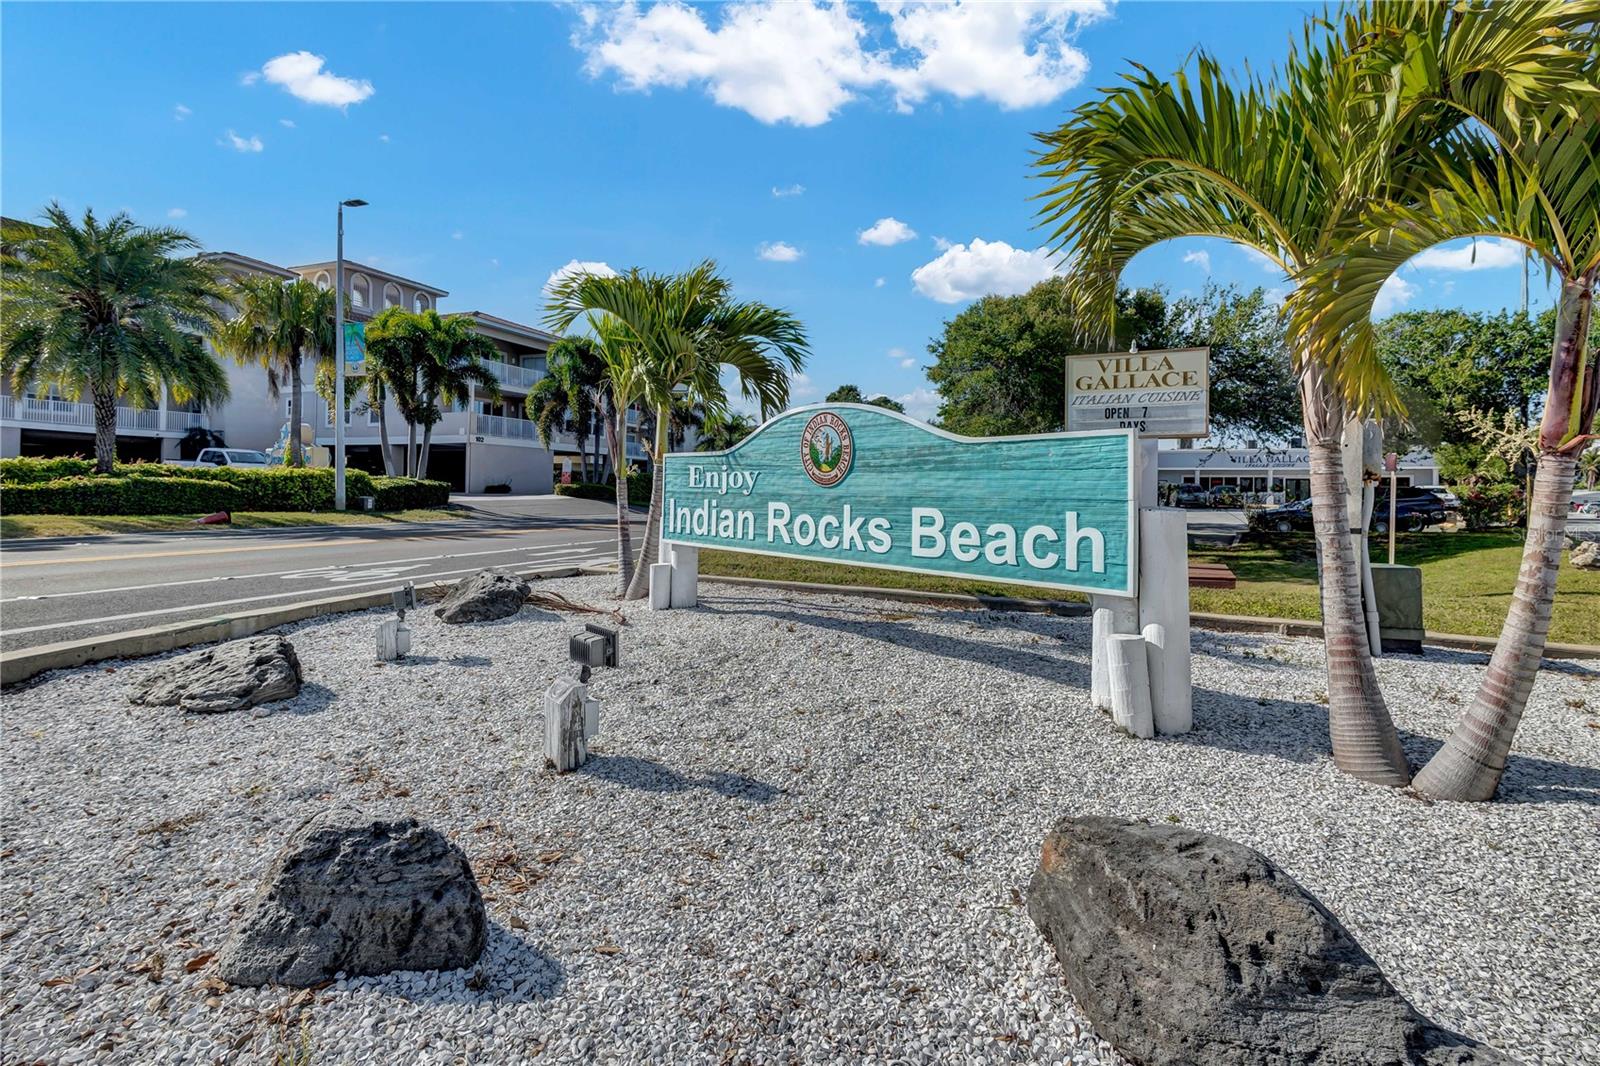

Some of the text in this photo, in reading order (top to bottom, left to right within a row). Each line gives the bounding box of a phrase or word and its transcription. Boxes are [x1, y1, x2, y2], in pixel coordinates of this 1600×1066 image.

[1097, 355, 1174, 373] VILLA
[1075, 370, 1198, 391] GALLACE
[1072, 390, 1201, 406] ITALIAN CUISINE
[1104, 406, 1148, 419] OPEN 7
[803, 415, 850, 475] CITY OF INDIAN ROCKS BEACH
[1267, 454, 1309, 463] GALLAC
[687, 464, 761, 496] Enjoy
[668, 498, 1106, 574] Indian Rocks Beach
